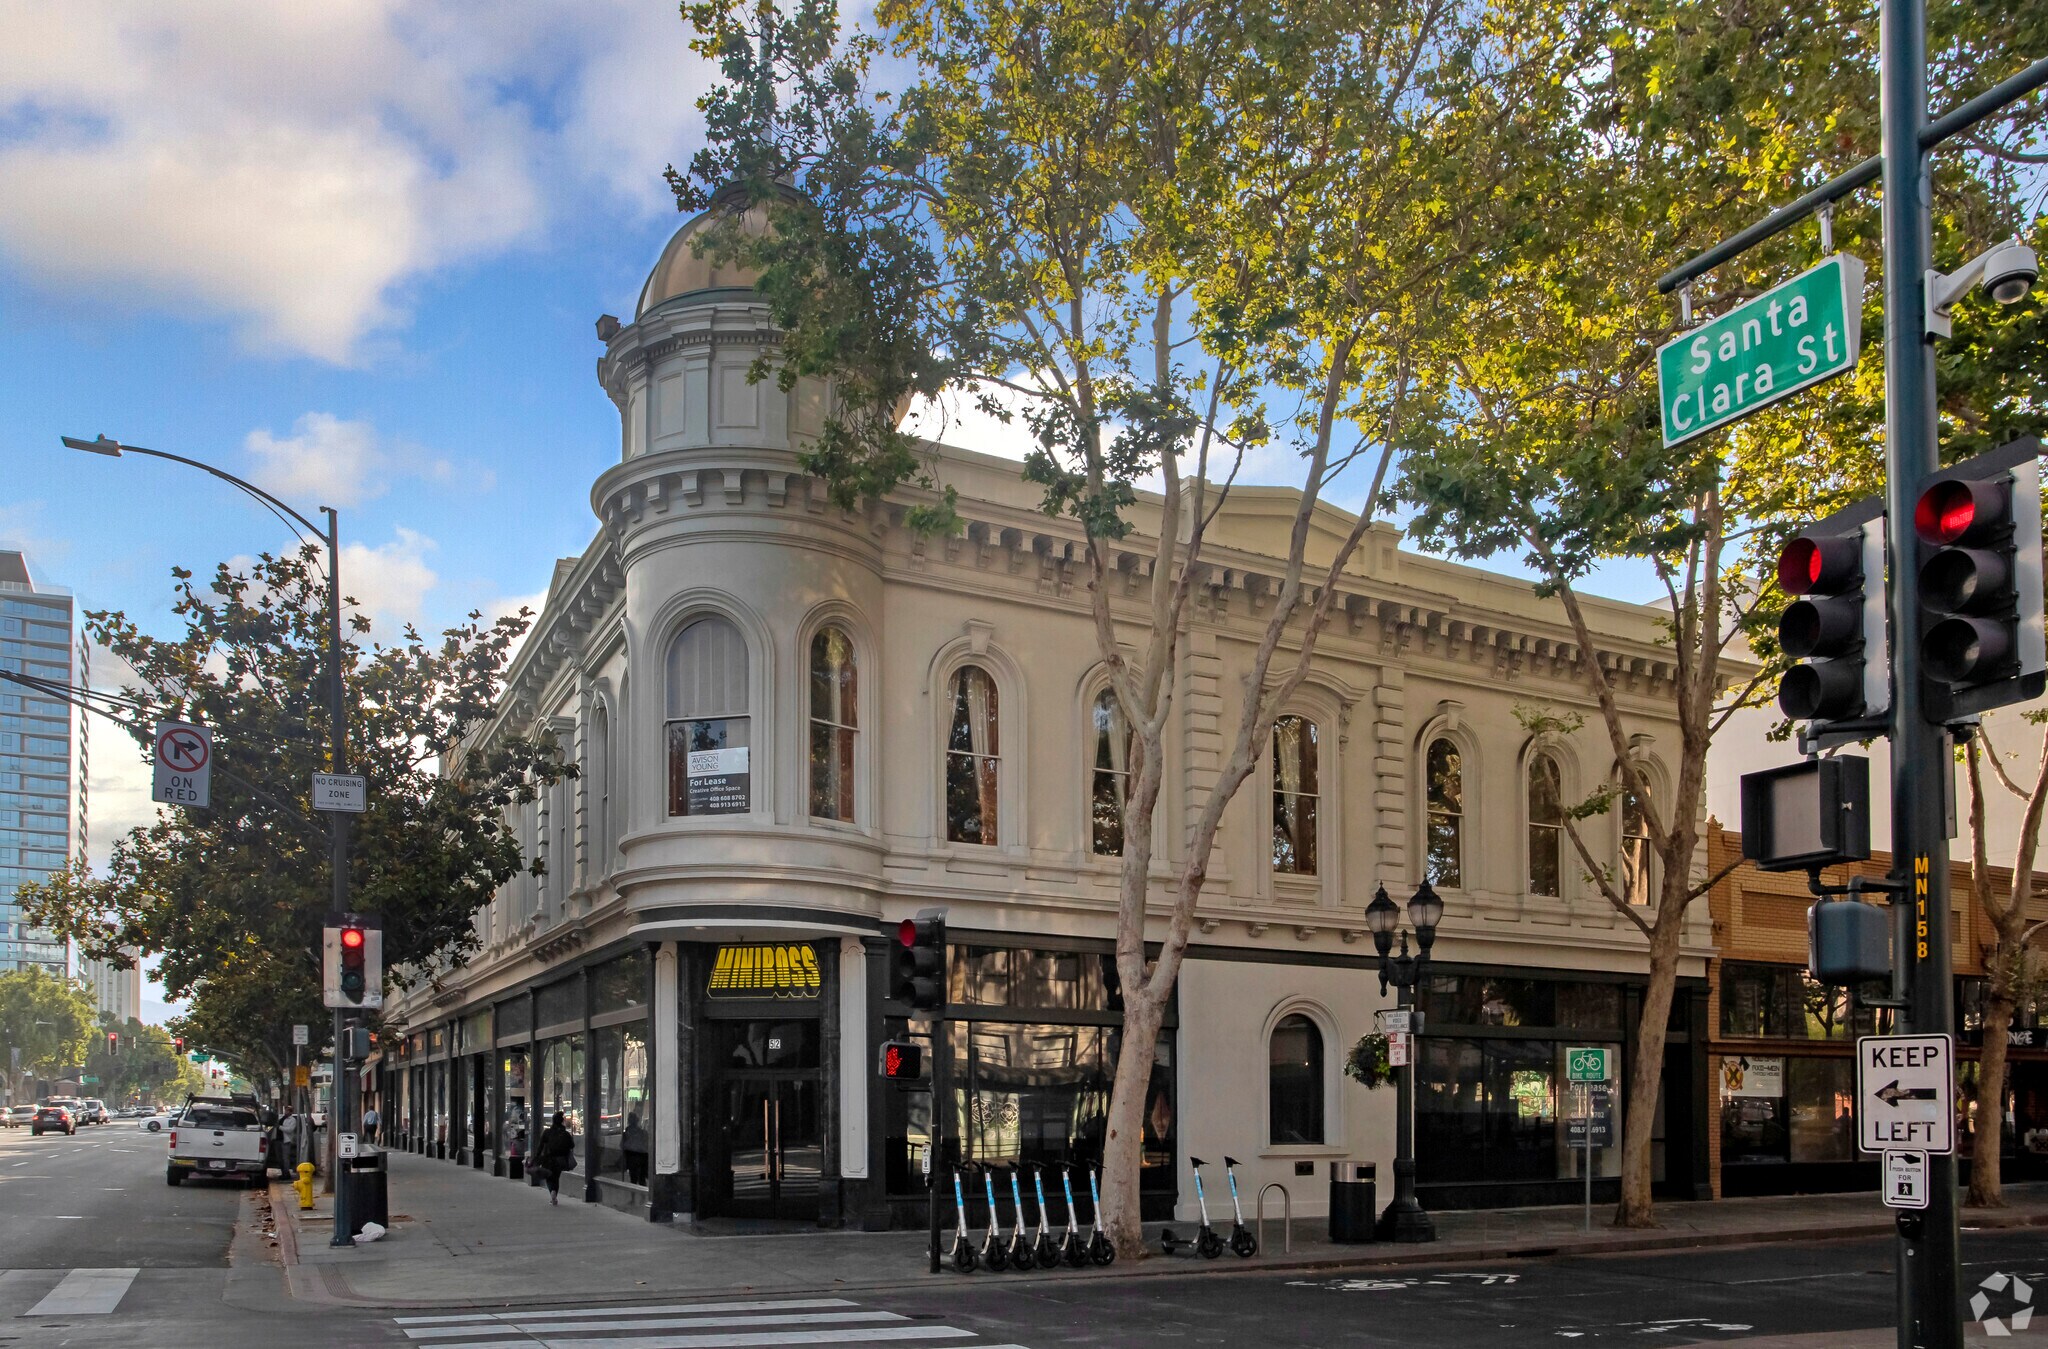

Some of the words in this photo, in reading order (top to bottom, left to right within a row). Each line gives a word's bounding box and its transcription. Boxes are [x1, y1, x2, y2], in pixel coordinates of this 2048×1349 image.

[1690, 295, 1808, 375] Santa
[1671, 363, 1774, 431] Clara
[1797, 322, 1839, 375] St
[692, 756, 719, 764] AVISON
[692, 762, 719, 770] YOUNG
[171, 775, 193, 789] ON
[315, 778, 326, 786] NO
[328, 778, 362, 788] CRUISING
[690, 779, 703, 787] For
[704, 778, 727, 786] Lease
[164, 787, 198, 801] RED
[328, 790, 350, 799] ZONE
[1914, 857, 1929, 958] MN158
[710, 945, 821, 989] MINIBOSS
[769, 1040, 780, 1049] 52
[1872, 1046, 1939, 1068] KEEP
[1585, 1072, 1602, 1080] ROUTE
[1570, 1081, 1583, 1092] For
[1874, 1120, 1936, 1142] LEFT
